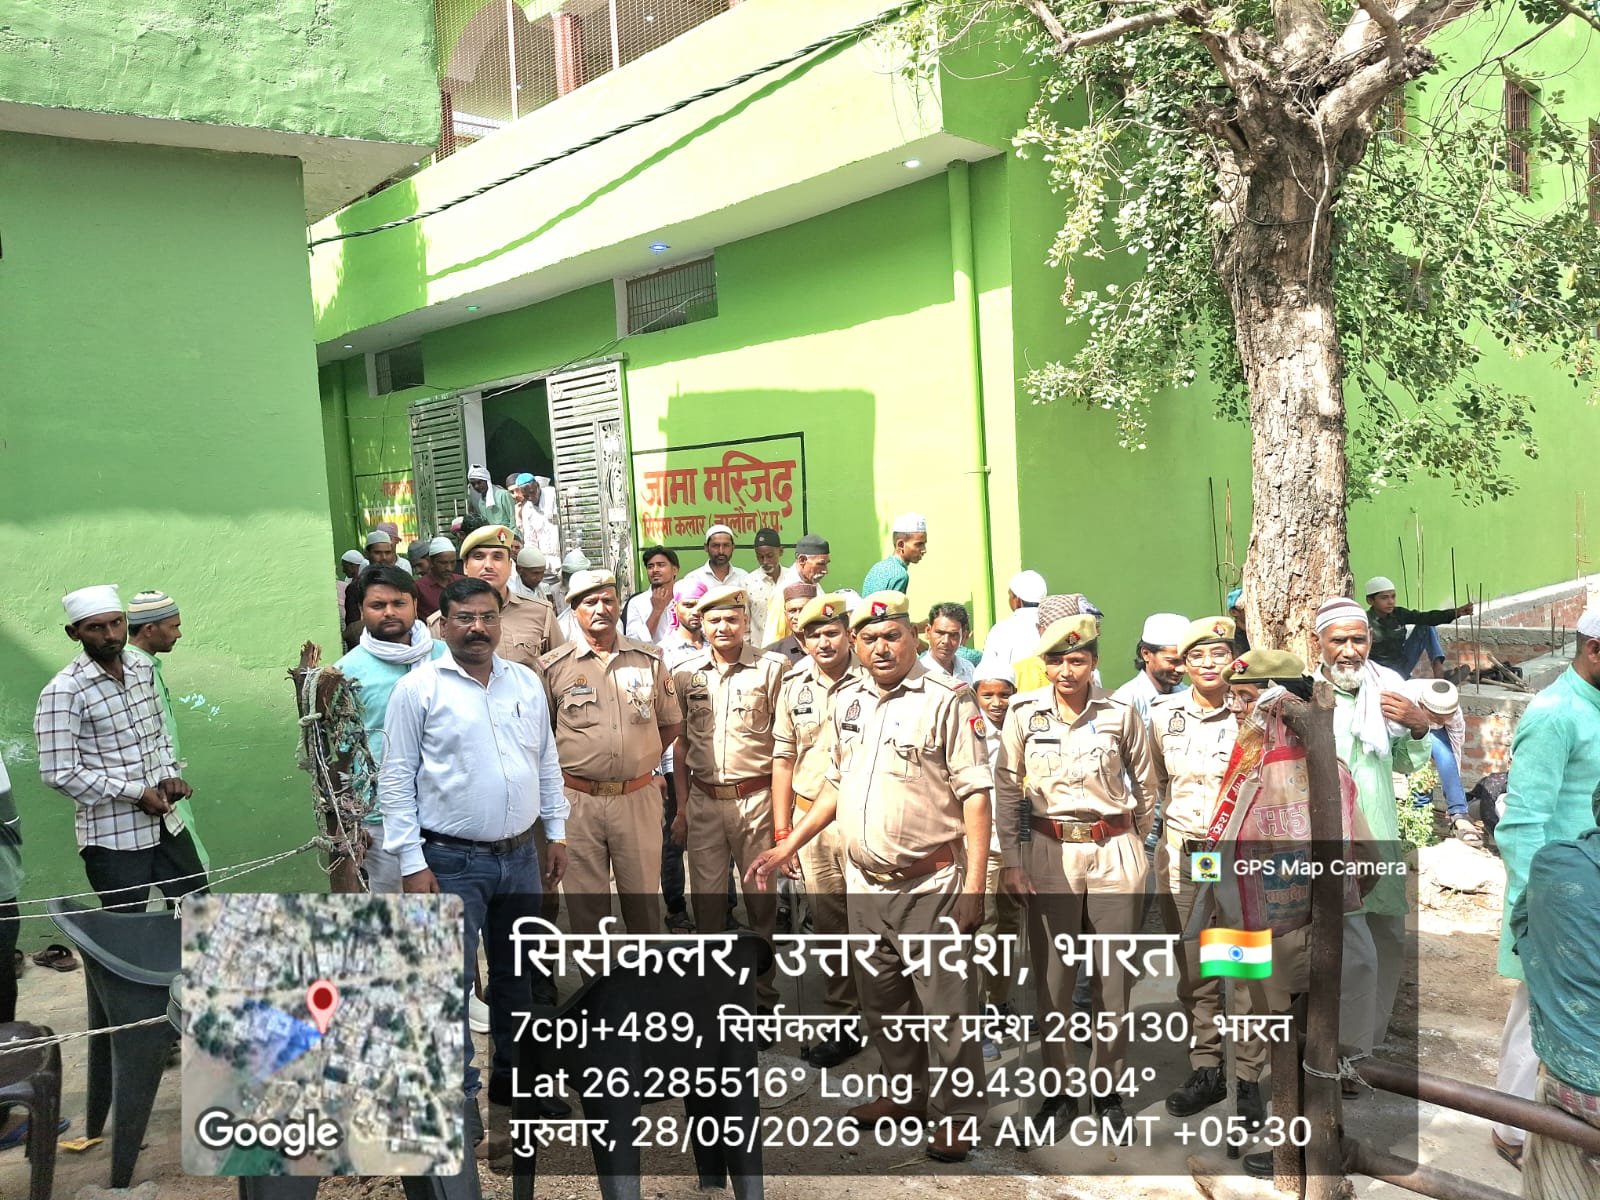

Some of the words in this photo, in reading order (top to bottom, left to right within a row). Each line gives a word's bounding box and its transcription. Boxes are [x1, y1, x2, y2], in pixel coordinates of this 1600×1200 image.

[641, 468, 698, 507] जामा
[703, 450, 797, 517] मस्जिद
[674, 515, 707, 538] कलार
